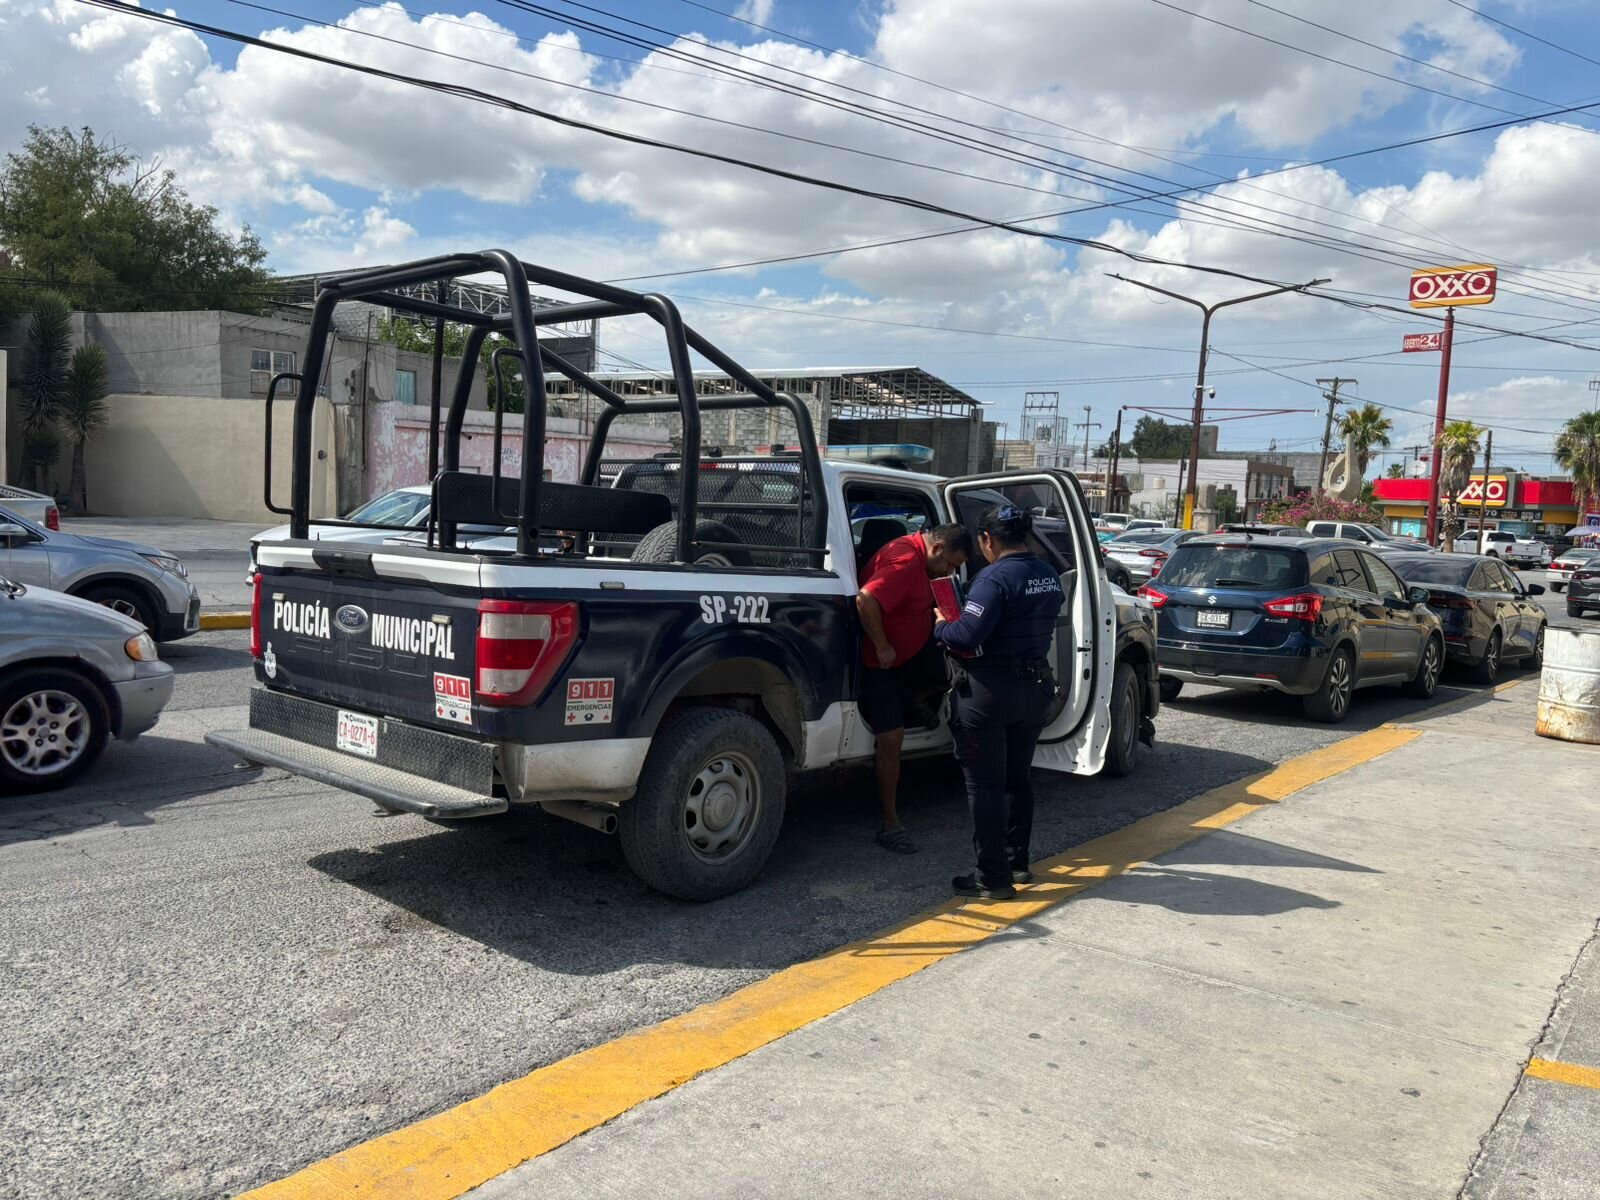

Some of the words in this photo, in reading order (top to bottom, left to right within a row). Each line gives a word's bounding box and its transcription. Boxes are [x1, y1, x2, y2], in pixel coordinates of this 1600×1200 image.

[1412, 272, 1491, 299] OXXO
[1421, 335, 1440, 345] 24
[1028, 577, 1057, 586] POLICIA
[1025, 585, 1061, 596] MUNICIPAL
[340, 609, 360, 625] Ford
[273, 600, 331, 639] POLICÍA
[371, 613, 455, 660] MUNICIPAL
[437, 678, 466, 699] 911
[571, 683, 609, 697] 911
[436, 698, 470, 711] EMERGENCIAS
[567, 703, 612, 712] EMERGENCIAS
